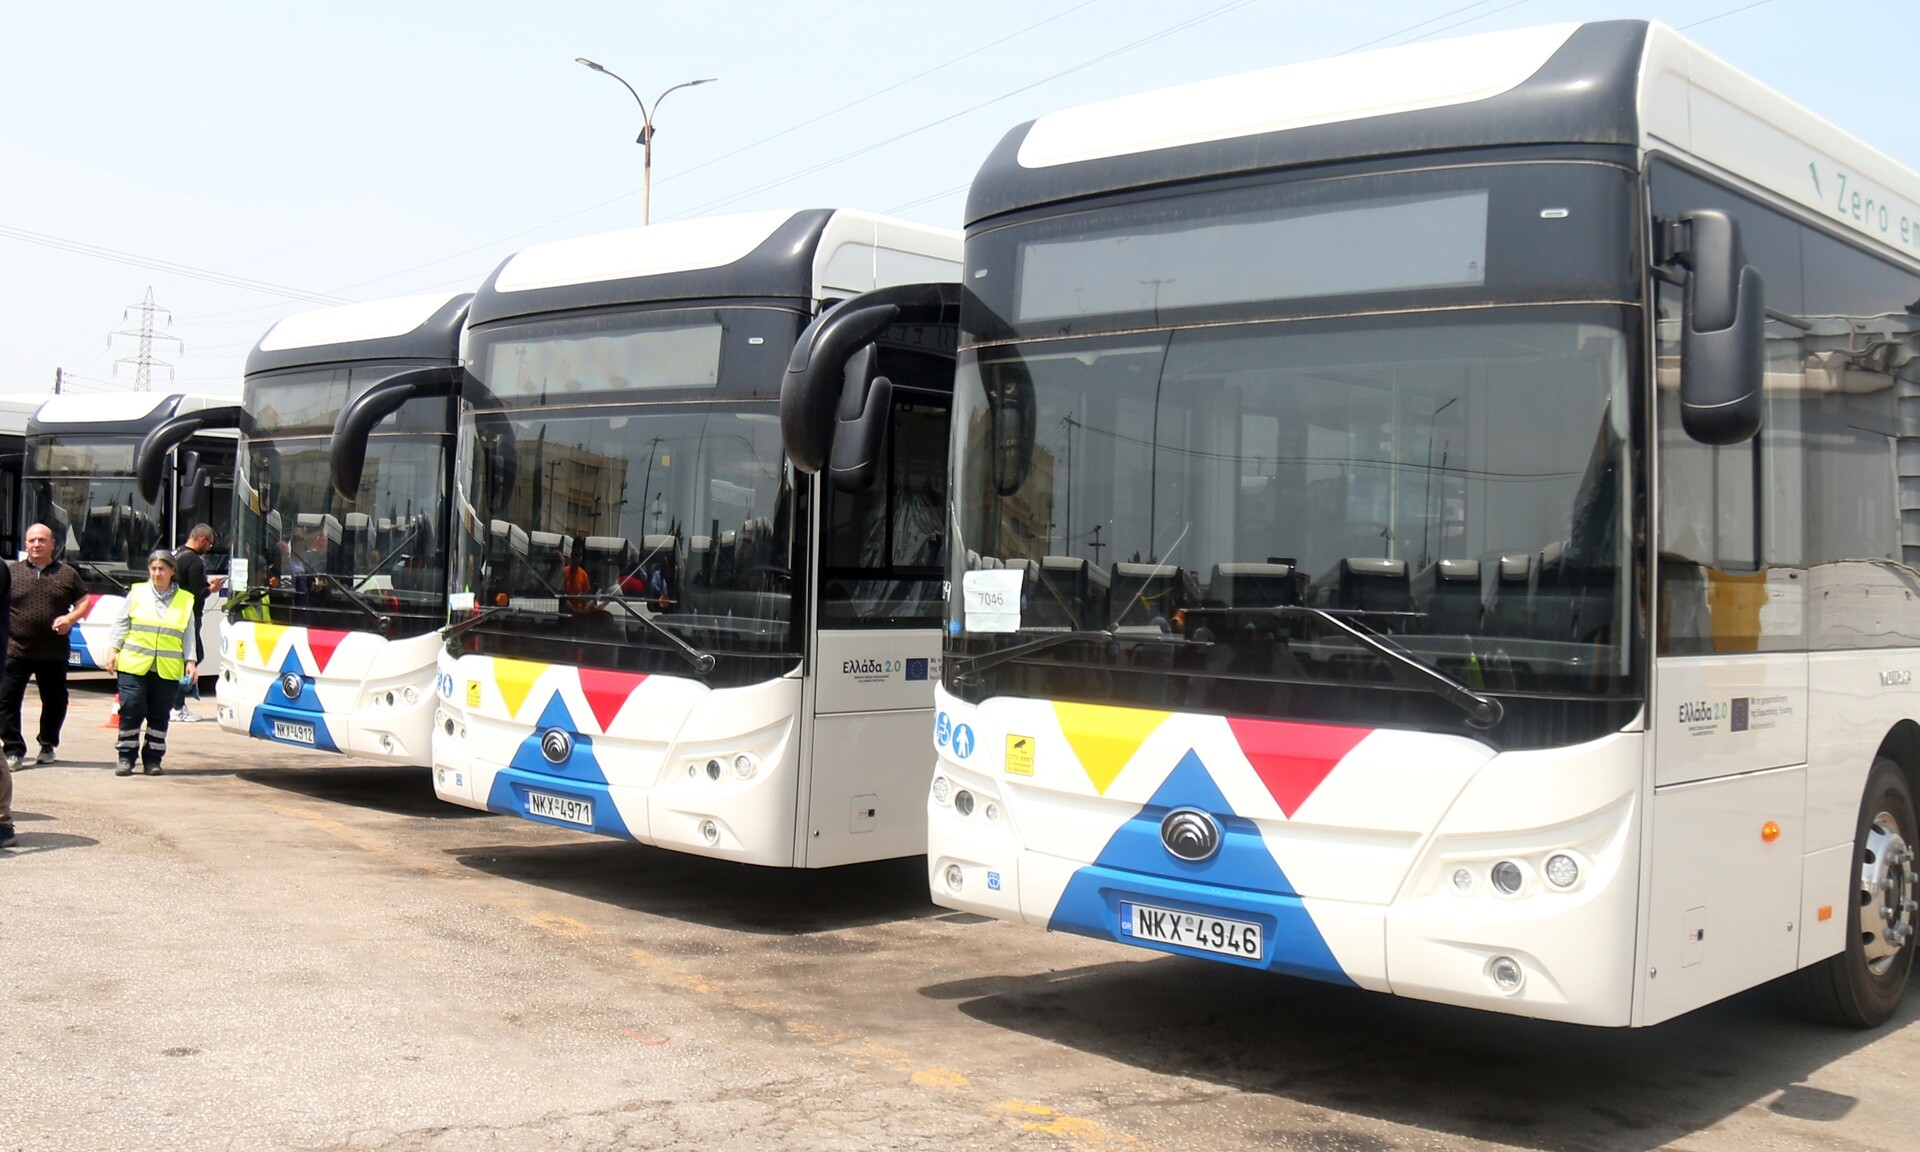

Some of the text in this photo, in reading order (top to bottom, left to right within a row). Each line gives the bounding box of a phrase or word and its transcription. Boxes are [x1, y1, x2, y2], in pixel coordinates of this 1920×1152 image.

[1837, 172, 1888, 233] Zero
[978, 592, 1004, 606] 7046
[843, 659, 901, 674] Ελλάδα 2.0
[1679, 700, 1712, 723] Ελλάδα
[532, 794, 590, 823] NKX-4971
[1122, 908, 1257, 954] GR NKX-4946
